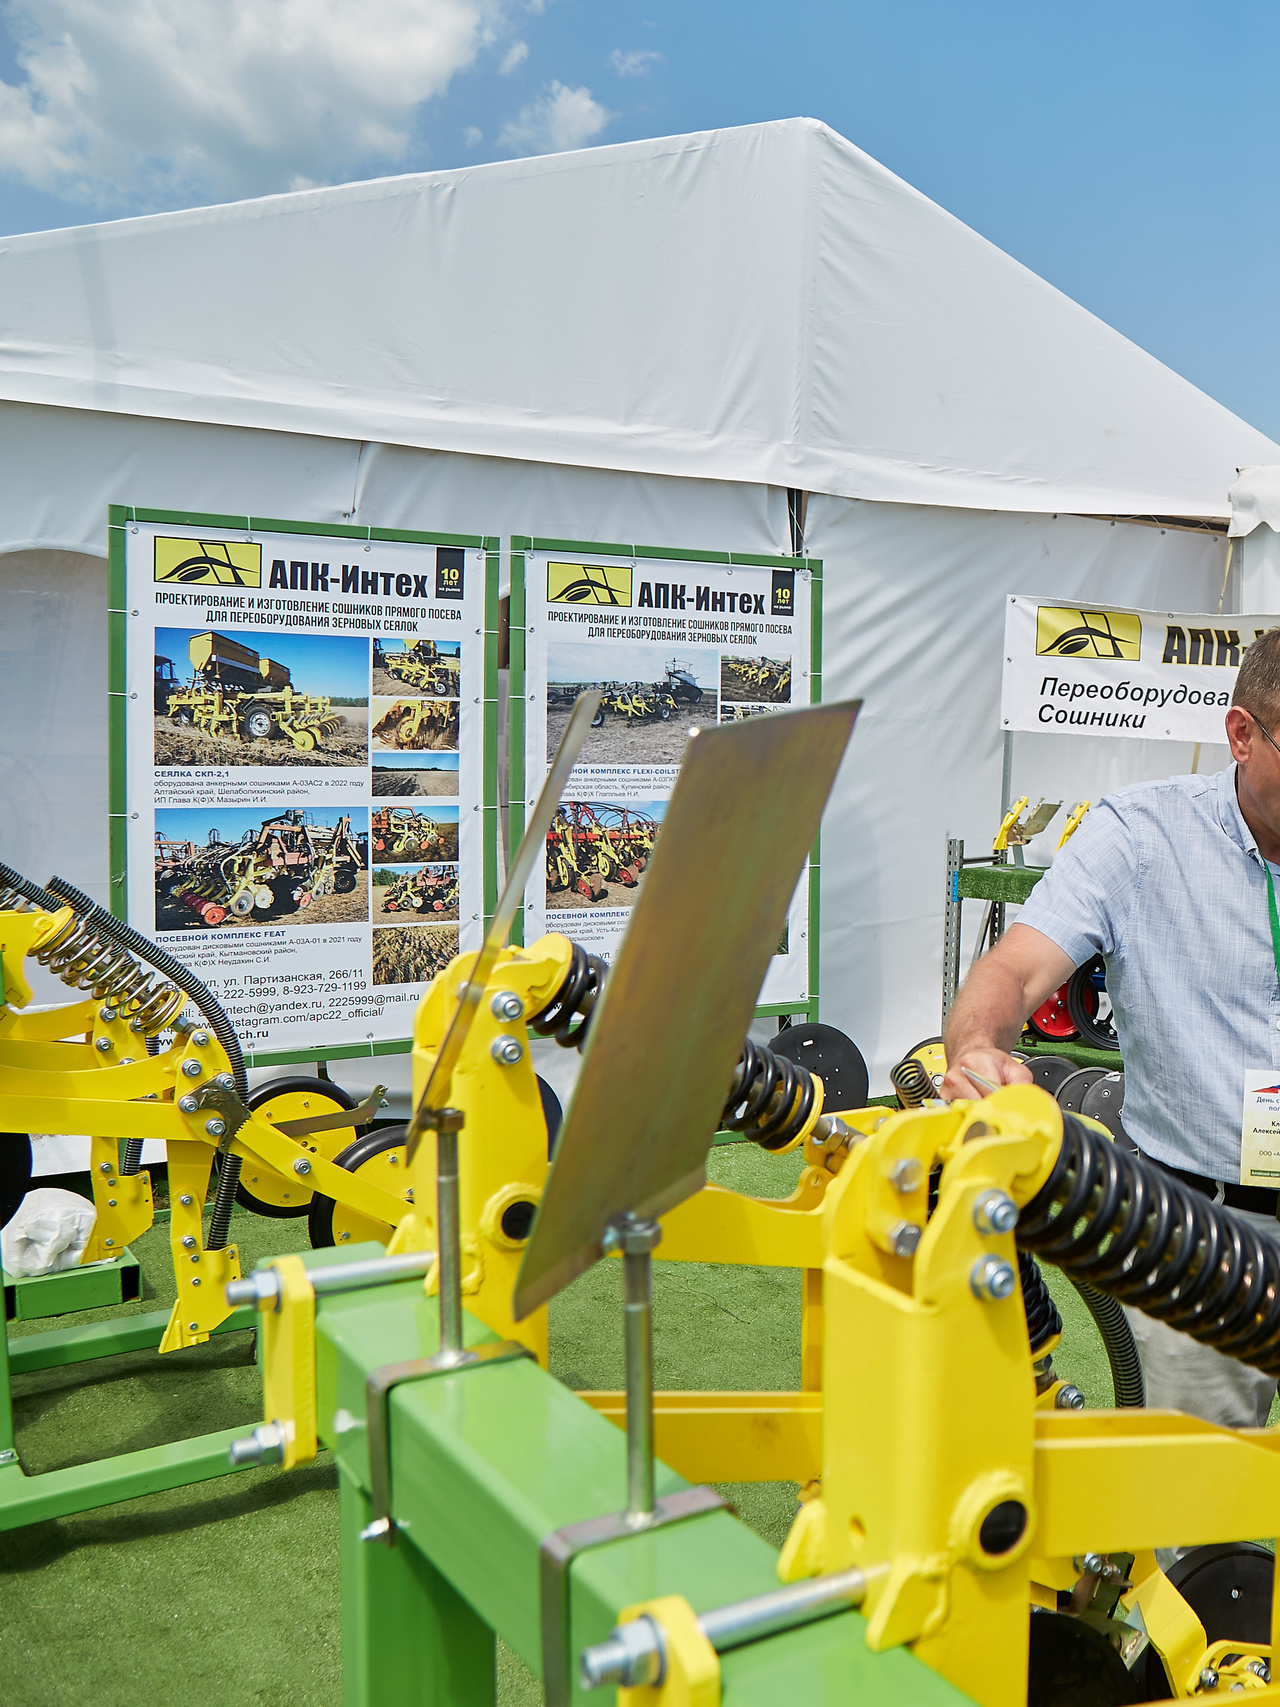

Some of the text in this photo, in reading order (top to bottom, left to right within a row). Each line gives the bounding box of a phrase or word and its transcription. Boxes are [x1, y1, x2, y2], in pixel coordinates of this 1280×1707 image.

[268, 559, 428, 599] АПК-Интех
[441, 568, 460, 581] 10
[638, 581, 765, 615] АПК-Интех
[775, 587, 791, 599] 10
[155, 592, 462, 620] ПРОЕКТИРОВАНИЕ И ИЗГОТОВЛЕНИЕ СОШНИКОВ ПРЯМОГО ПОСЕВА
[206, 610, 418, 632] ДЛЯ ПЕРЕОБОРУДОВАНИЯ ЗЕРНОВЫХ СЕЯЛОК
[547, 611, 792, 634] ПРОЕКТИРОВАНИЕ И ИЗГОТОВЛЕНИЕ СОШНИКОВ ПРЯМОГО ПОСЕВА
[588, 627, 758, 645] ДЛЯ ПЕРЕОБОРУДОВАНИЯ ЗЕРНОВЫХ СЕЯЛОК
[1039, 676, 1230, 709] Переоборудова
[1038, 703, 1147, 730] Сошники
[193, 796, 215, 804] К(Ф)Х
[546, 911, 588, 920] ПОСЕВНОЙ
[155, 930, 286, 943] ПОСЕВНОЙ КОМПЛЕКС FEAT
[202, 942, 244, 950] дисковыми
[223, 979, 240, 988] ул.
[244, 973, 326, 986] Партизанская,
[328, 968, 364, 979] 266/11
[282, 981, 367, 996] 8-923-729-1199
[328, 993, 420, 1008] 2225999@mail.ru
[1252, 1127, 1280, 1135] Алексей
